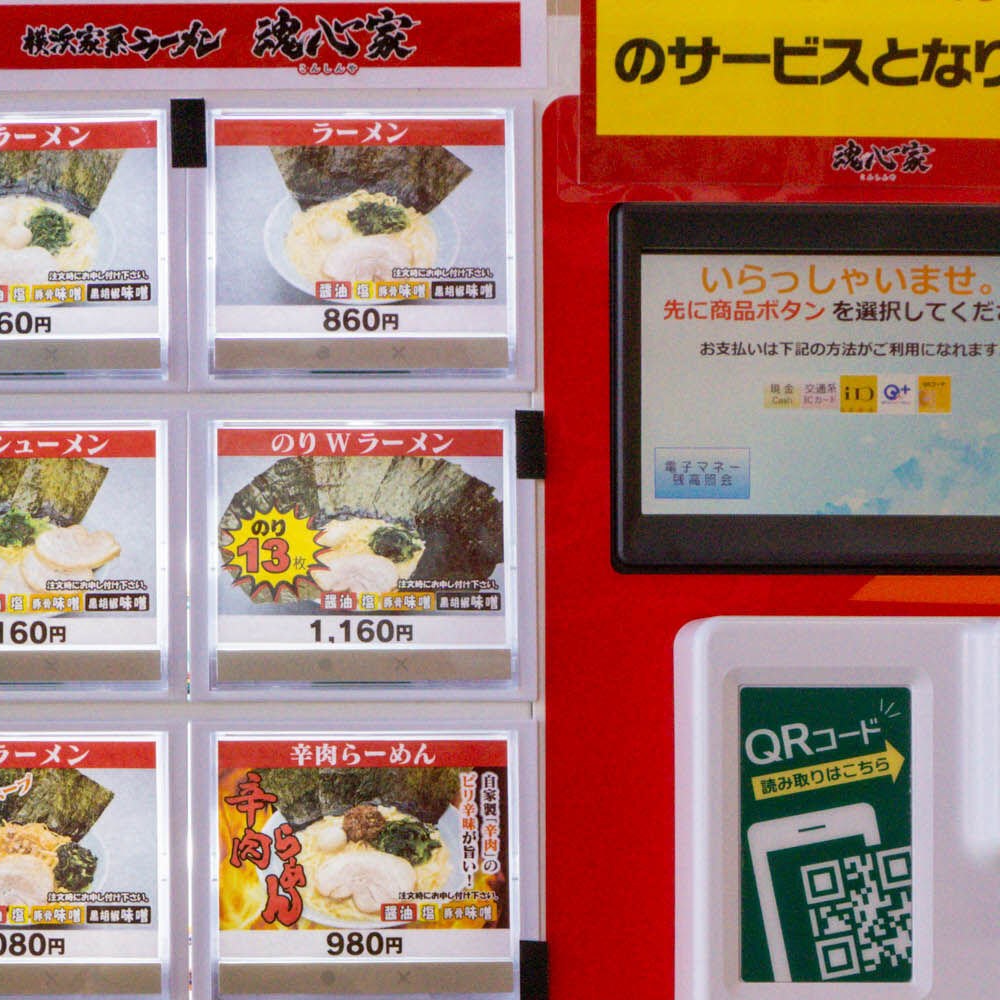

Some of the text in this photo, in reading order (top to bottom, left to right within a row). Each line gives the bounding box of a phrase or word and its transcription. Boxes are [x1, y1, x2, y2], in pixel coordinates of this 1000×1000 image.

[21, 7, 421, 61] 横浜家系ラーメン 魂心家
[298, 62, 361, 76] こんしんや
[311, 122, 409, 144] ラーメン
[831, 139, 936, 174] 魂心家
[700, 264, 993, 295] いらっしゃいませ。
[13, 286, 27, 302] 塩
[322, 308, 399, 332] 860円
[663, 300, 1000, 322] 先に商品ボタン を選択してくだ
[699, 341, 999, 358] お支払いは下記の方法がご利用になれます
[664, 460, 741, 473] 電子マネー
[251, 519, 287, 537] のり
[309, 619, 414, 644] 1,160円
[744, 716, 882, 765] QRコード
[289, 743, 437, 766] 辛肉らーめん
[759, 755, 891, 795] 読み取りはこちら
[421, 905, 436, 921] 塩
[326, 932, 403, 956] 980円
